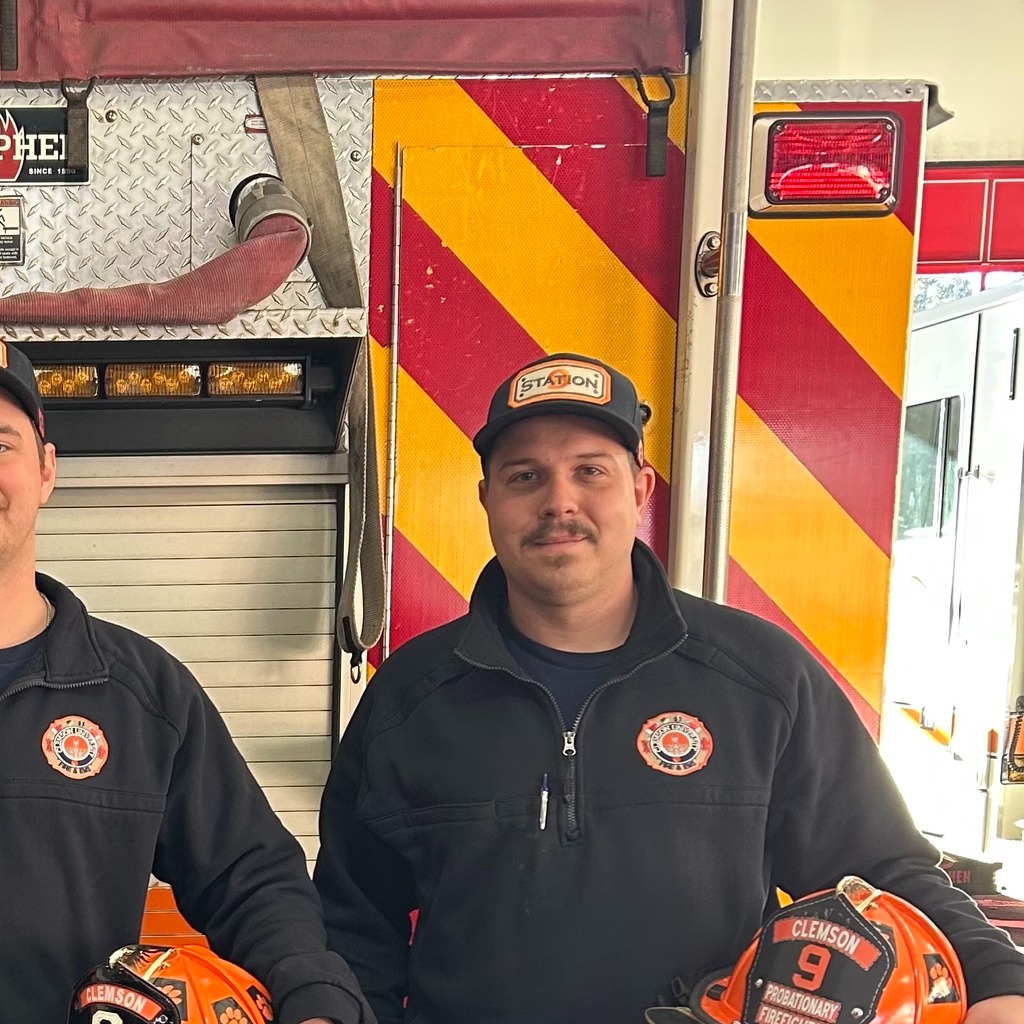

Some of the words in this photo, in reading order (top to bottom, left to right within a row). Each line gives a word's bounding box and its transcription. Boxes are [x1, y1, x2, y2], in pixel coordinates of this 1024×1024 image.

[521, 374, 598, 392] STATION
[792, 920, 861, 955] CLEMSON
[792, 944, 832, 991] 9
[86, 987, 146, 1014] CLEMSON
[764, 984, 838, 1020] PROBATIONARY
